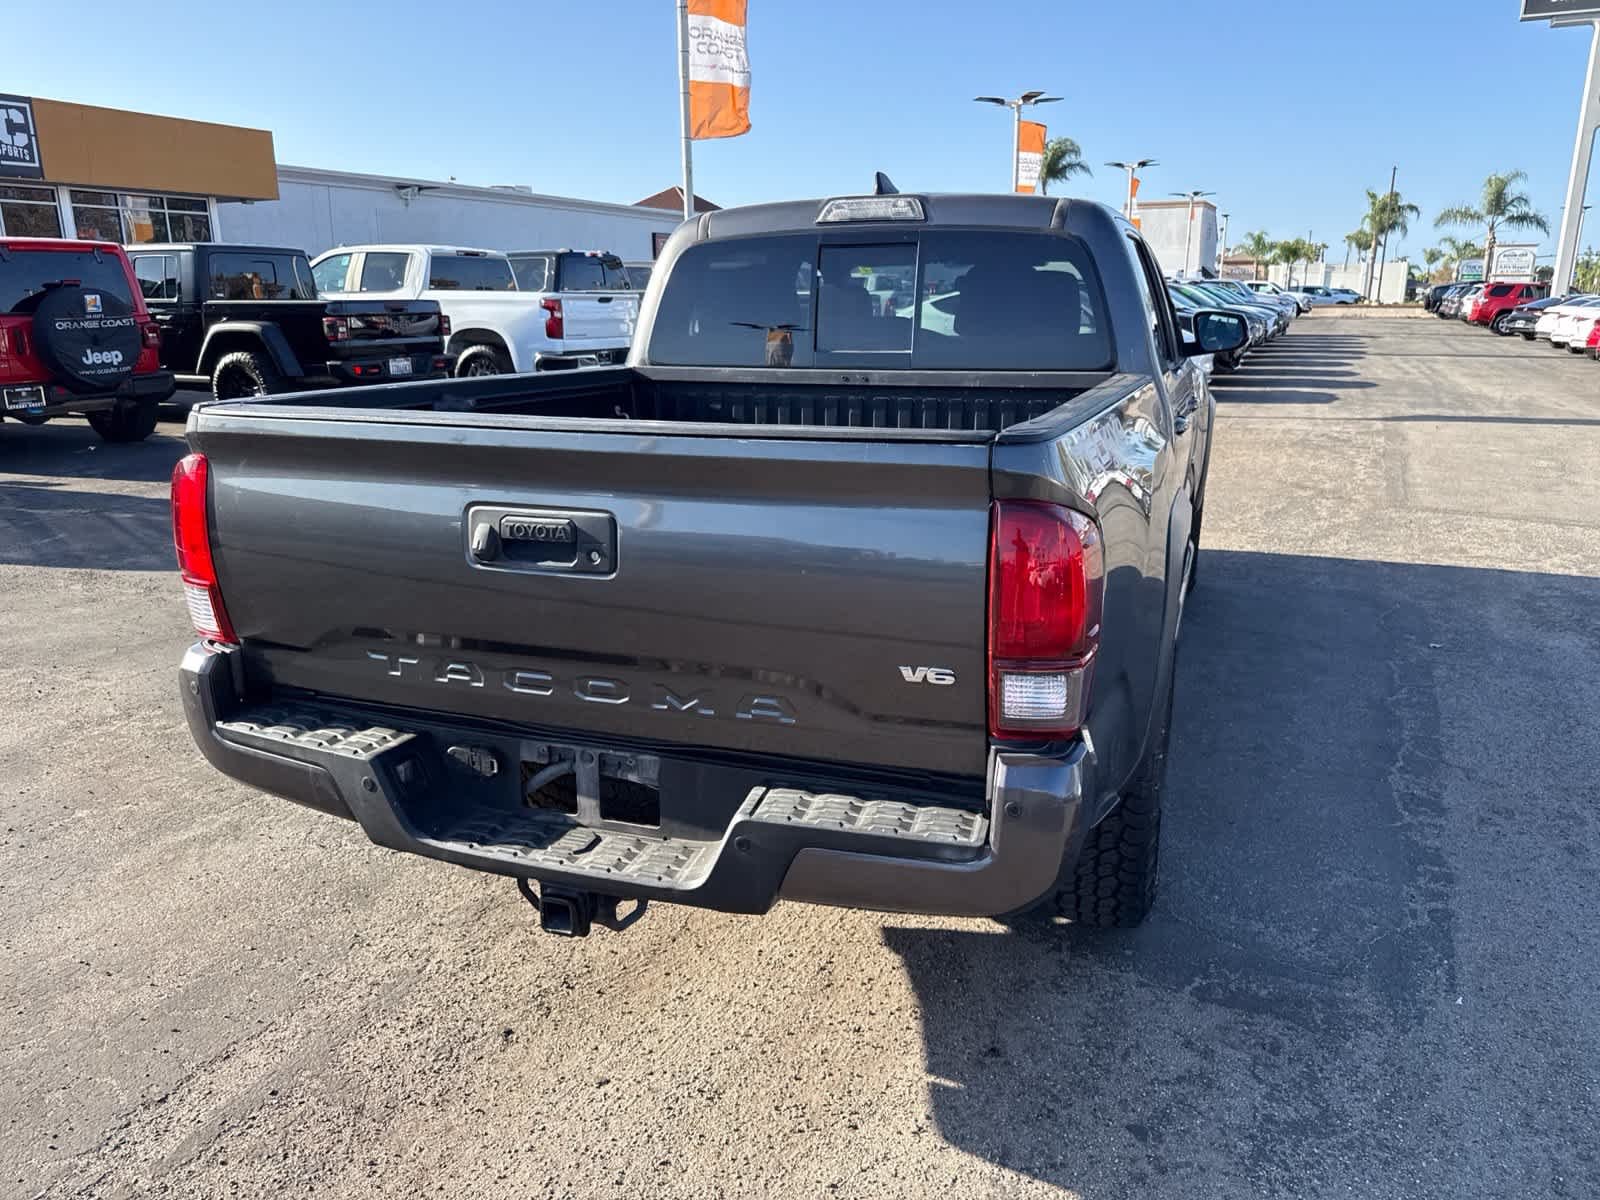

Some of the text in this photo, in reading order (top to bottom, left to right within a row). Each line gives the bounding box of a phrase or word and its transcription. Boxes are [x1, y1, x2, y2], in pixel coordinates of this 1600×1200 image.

[0, 144, 30, 161] PORTS
[55, 317, 135, 330] ORANGE COAST
[82, 348, 123, 365] Jeep
[503, 522, 567, 539] TOYOTA
[898, 665, 956, 685] V6
[366, 650, 798, 724] TACOMA
